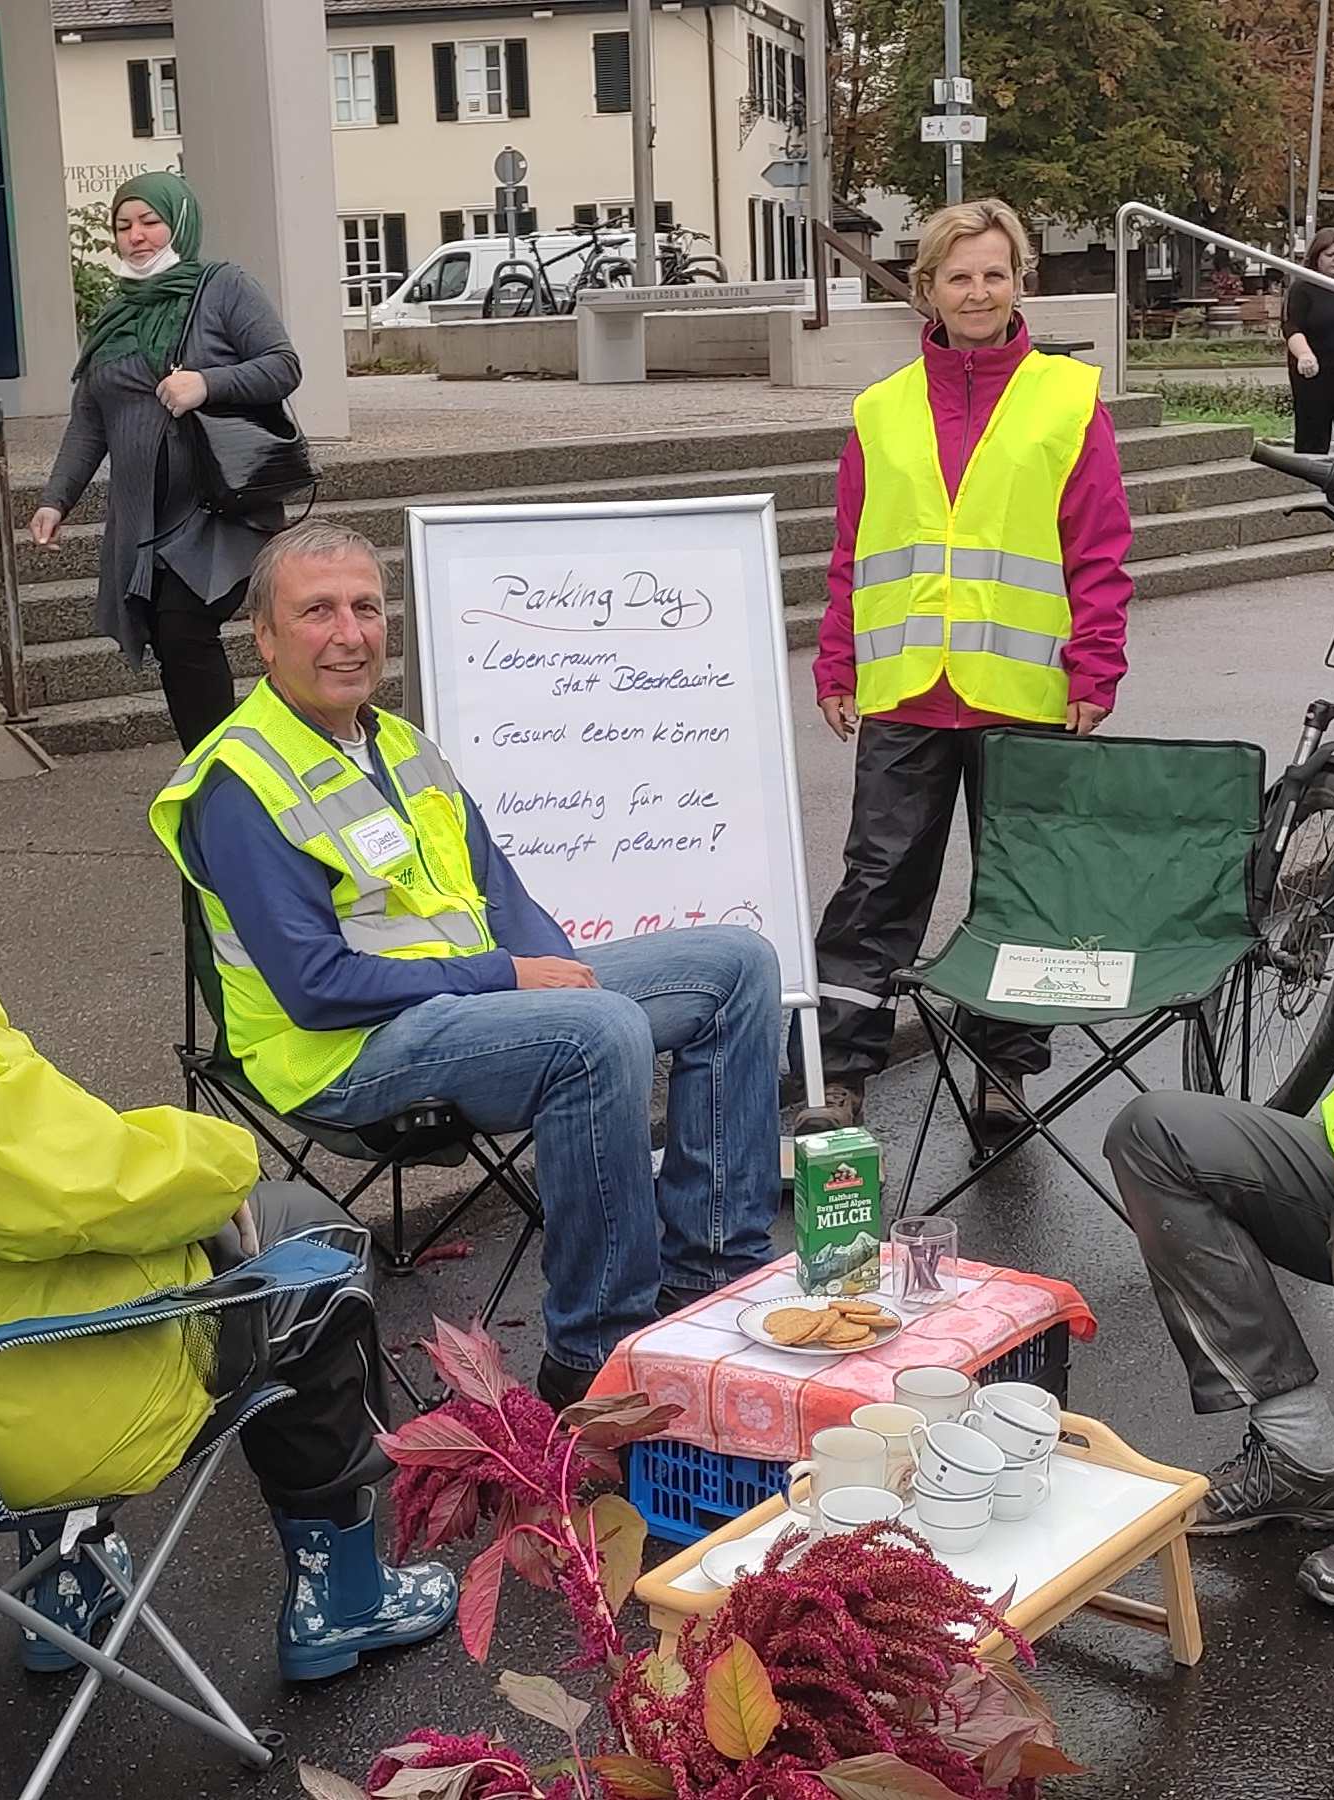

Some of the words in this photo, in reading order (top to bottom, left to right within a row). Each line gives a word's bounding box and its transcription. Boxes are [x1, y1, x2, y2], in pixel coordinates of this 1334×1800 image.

[77, 179, 128, 193] HOTE
[492, 570, 614, 627] Parking
[623, 571, 700, 627] Day
[482, 640, 617, 670] Lebensraum
[551, 673, 600, 696] statt
[493, 723, 568, 747] Gesund
[581, 722, 645, 744] leben
[652, 721, 730, 745] können
[496, 790, 605, 820] Nachhaltig
[629, 783, 663, 815] für
[677, 790, 720, 809] die
[494, 833, 597, 862] Zukunft
[551, 907, 614, 940] ach
[817, 1207, 872, 1229] MILCH
